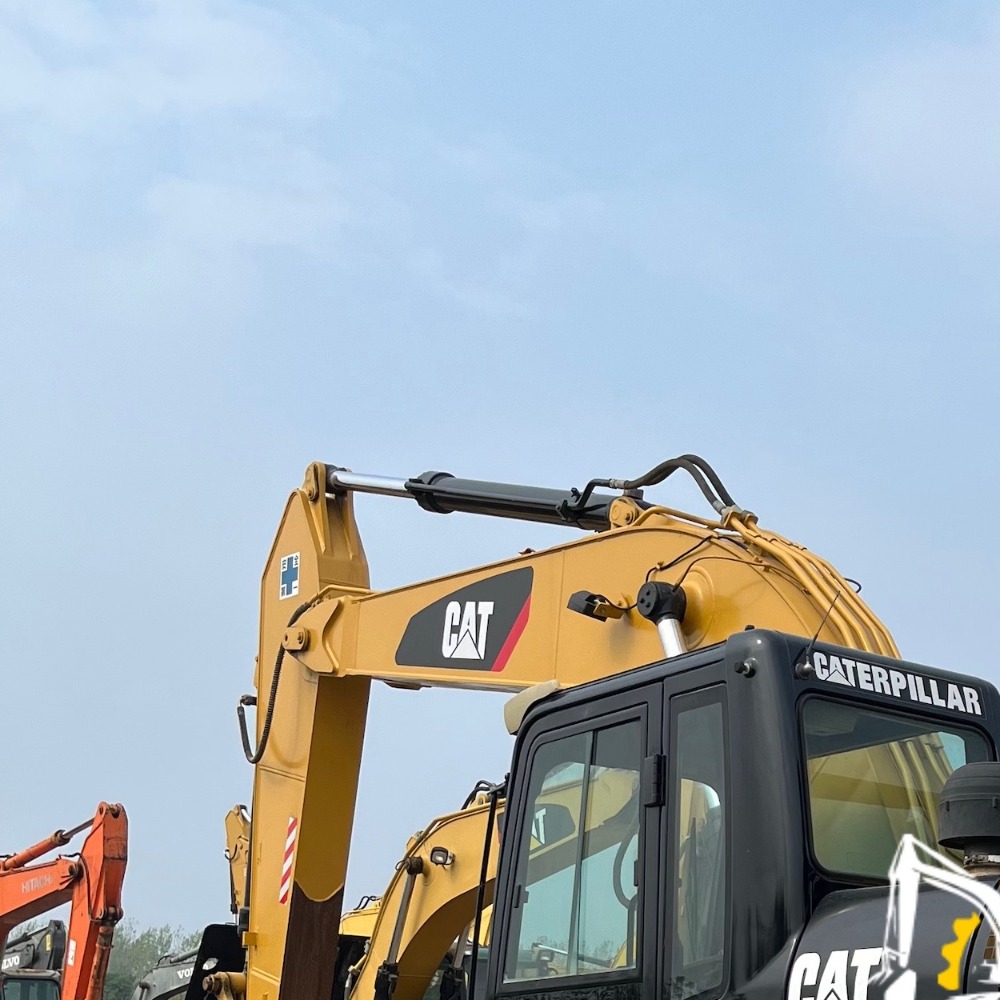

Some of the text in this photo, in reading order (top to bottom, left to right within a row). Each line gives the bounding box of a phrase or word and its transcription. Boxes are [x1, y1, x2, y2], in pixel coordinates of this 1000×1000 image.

[442, 601, 494, 660] CAT
[813, 651, 982, 716] CATERPILLAR
[21, 875, 53, 893] HITACHI
[1, 955, 20, 970] LVO
